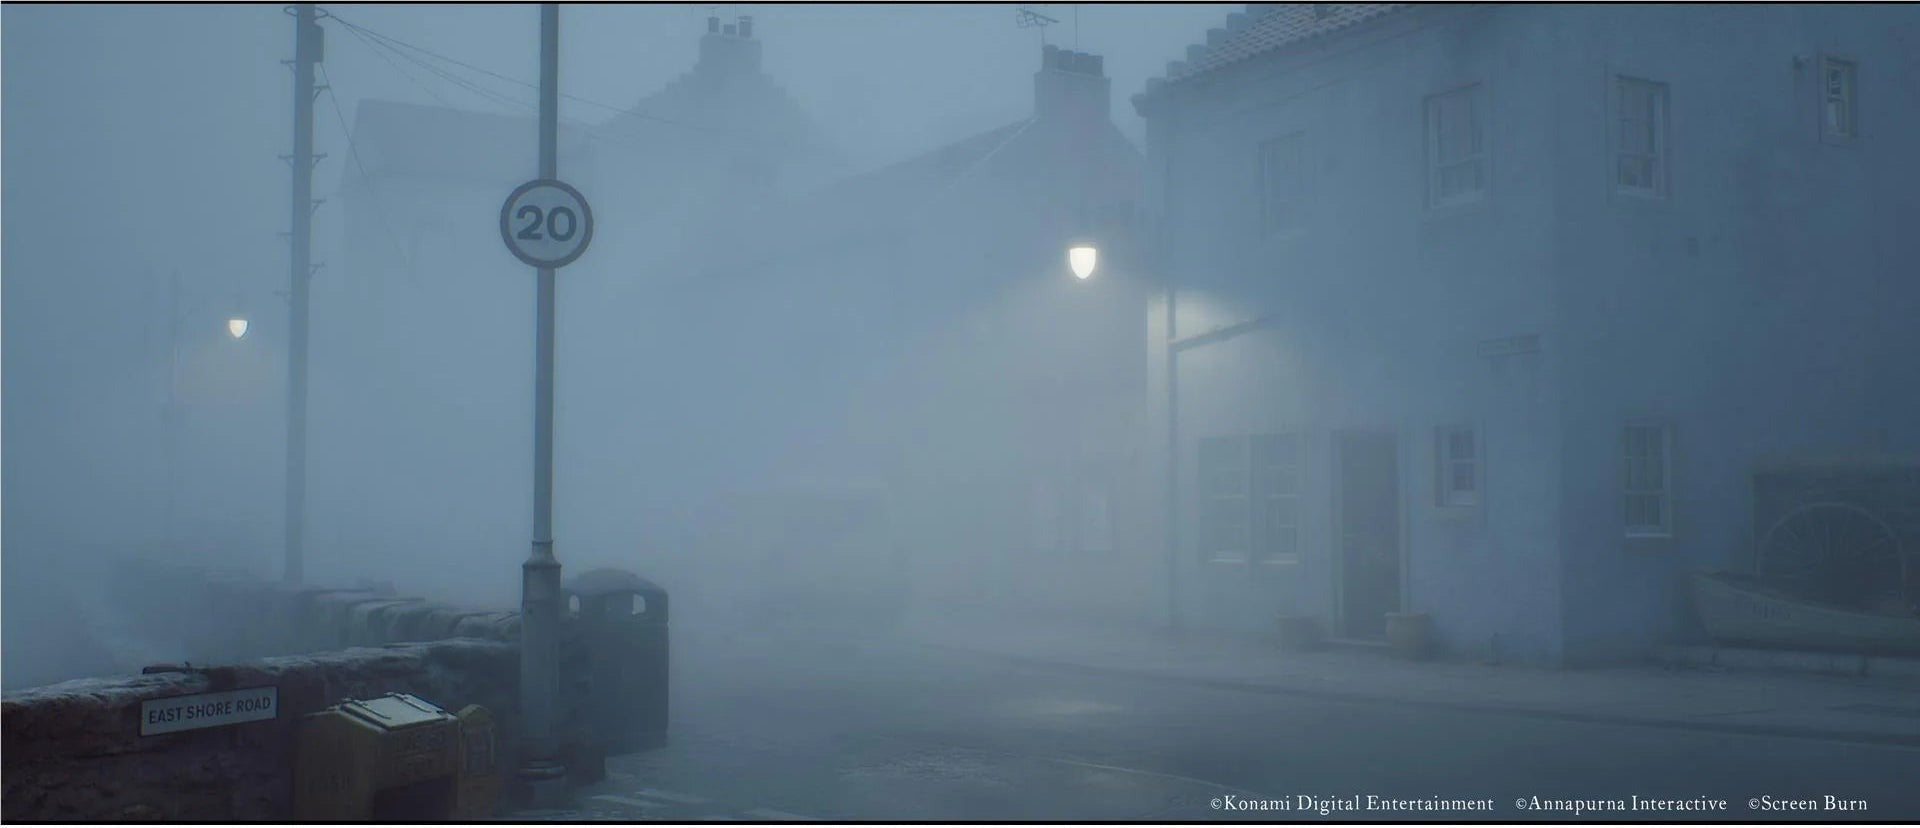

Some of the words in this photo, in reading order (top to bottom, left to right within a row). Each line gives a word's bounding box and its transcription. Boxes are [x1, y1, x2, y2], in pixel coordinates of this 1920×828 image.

[516, 205, 577, 241] 20
[148, 707, 183, 725] EAST
[186, 701, 233, 719] SHORE
[236, 696, 271, 713] ROAD
